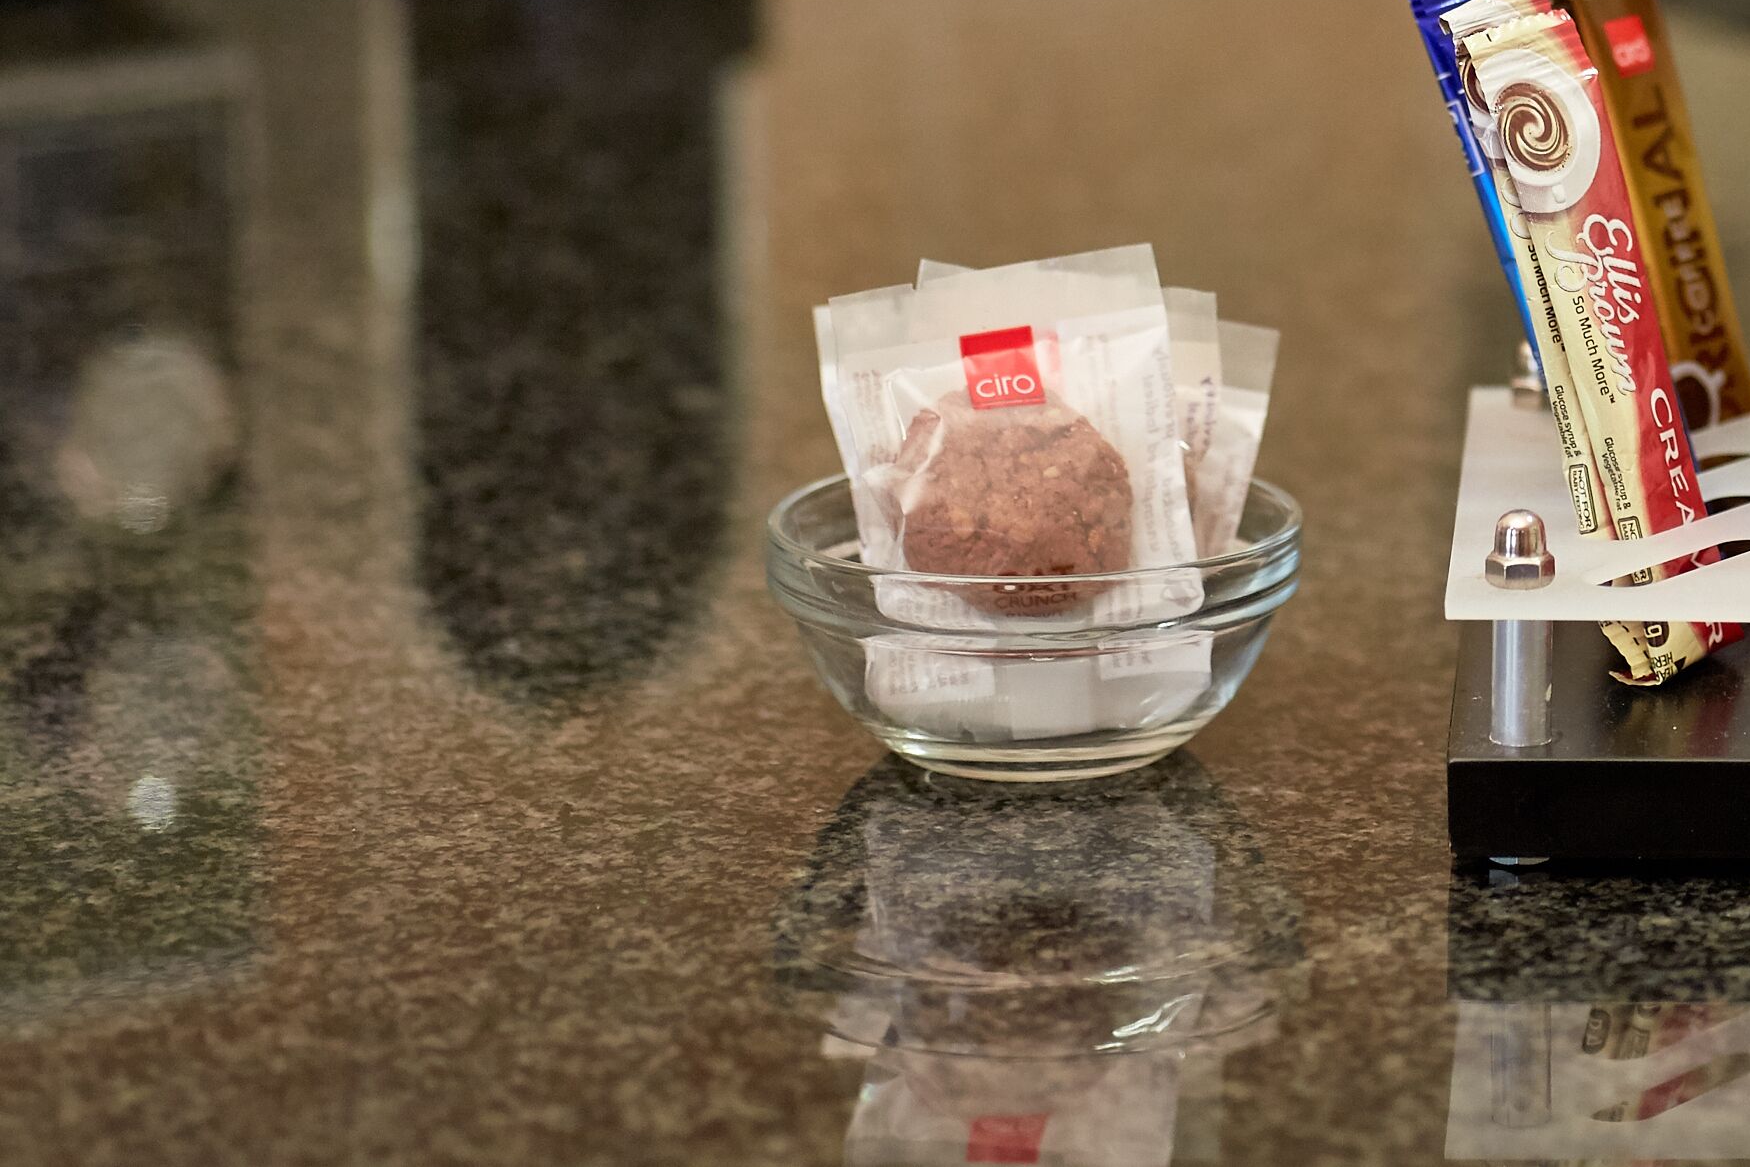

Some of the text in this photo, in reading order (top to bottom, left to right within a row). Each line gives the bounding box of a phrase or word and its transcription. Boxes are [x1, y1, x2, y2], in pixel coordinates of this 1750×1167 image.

[1571, 294, 1588, 315] So
[1577, 316, 1600, 357] Much
[975, 370, 1036, 400] ciro
[1554, 384, 1570, 422] Glucose
[1561, 421, 1577, 450] syrup
[1579, 499, 1594, 529] FOR
[994, 592, 1078, 609] CRUNCH
